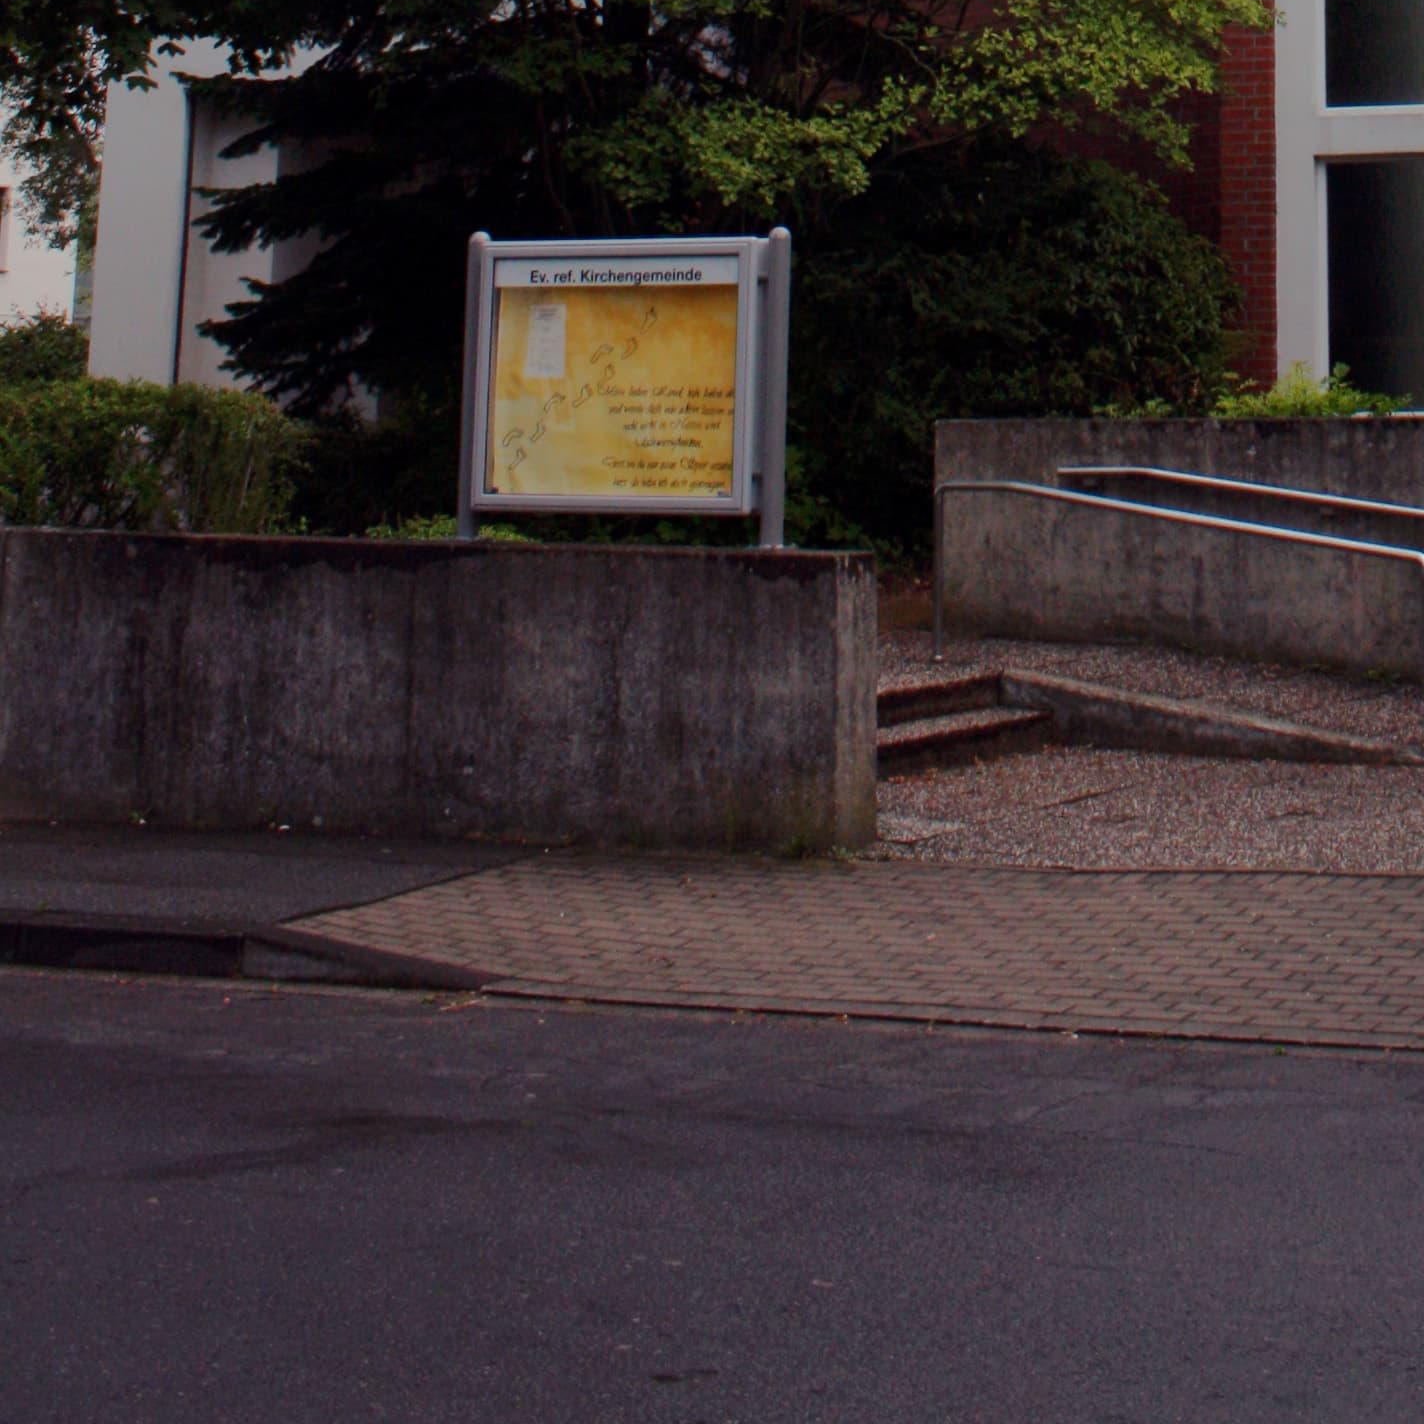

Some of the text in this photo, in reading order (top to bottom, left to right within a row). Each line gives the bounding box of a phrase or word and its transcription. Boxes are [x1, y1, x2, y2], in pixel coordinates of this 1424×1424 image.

[530, 267, 703, 286] Ev. ref. Kirchengemeinde
